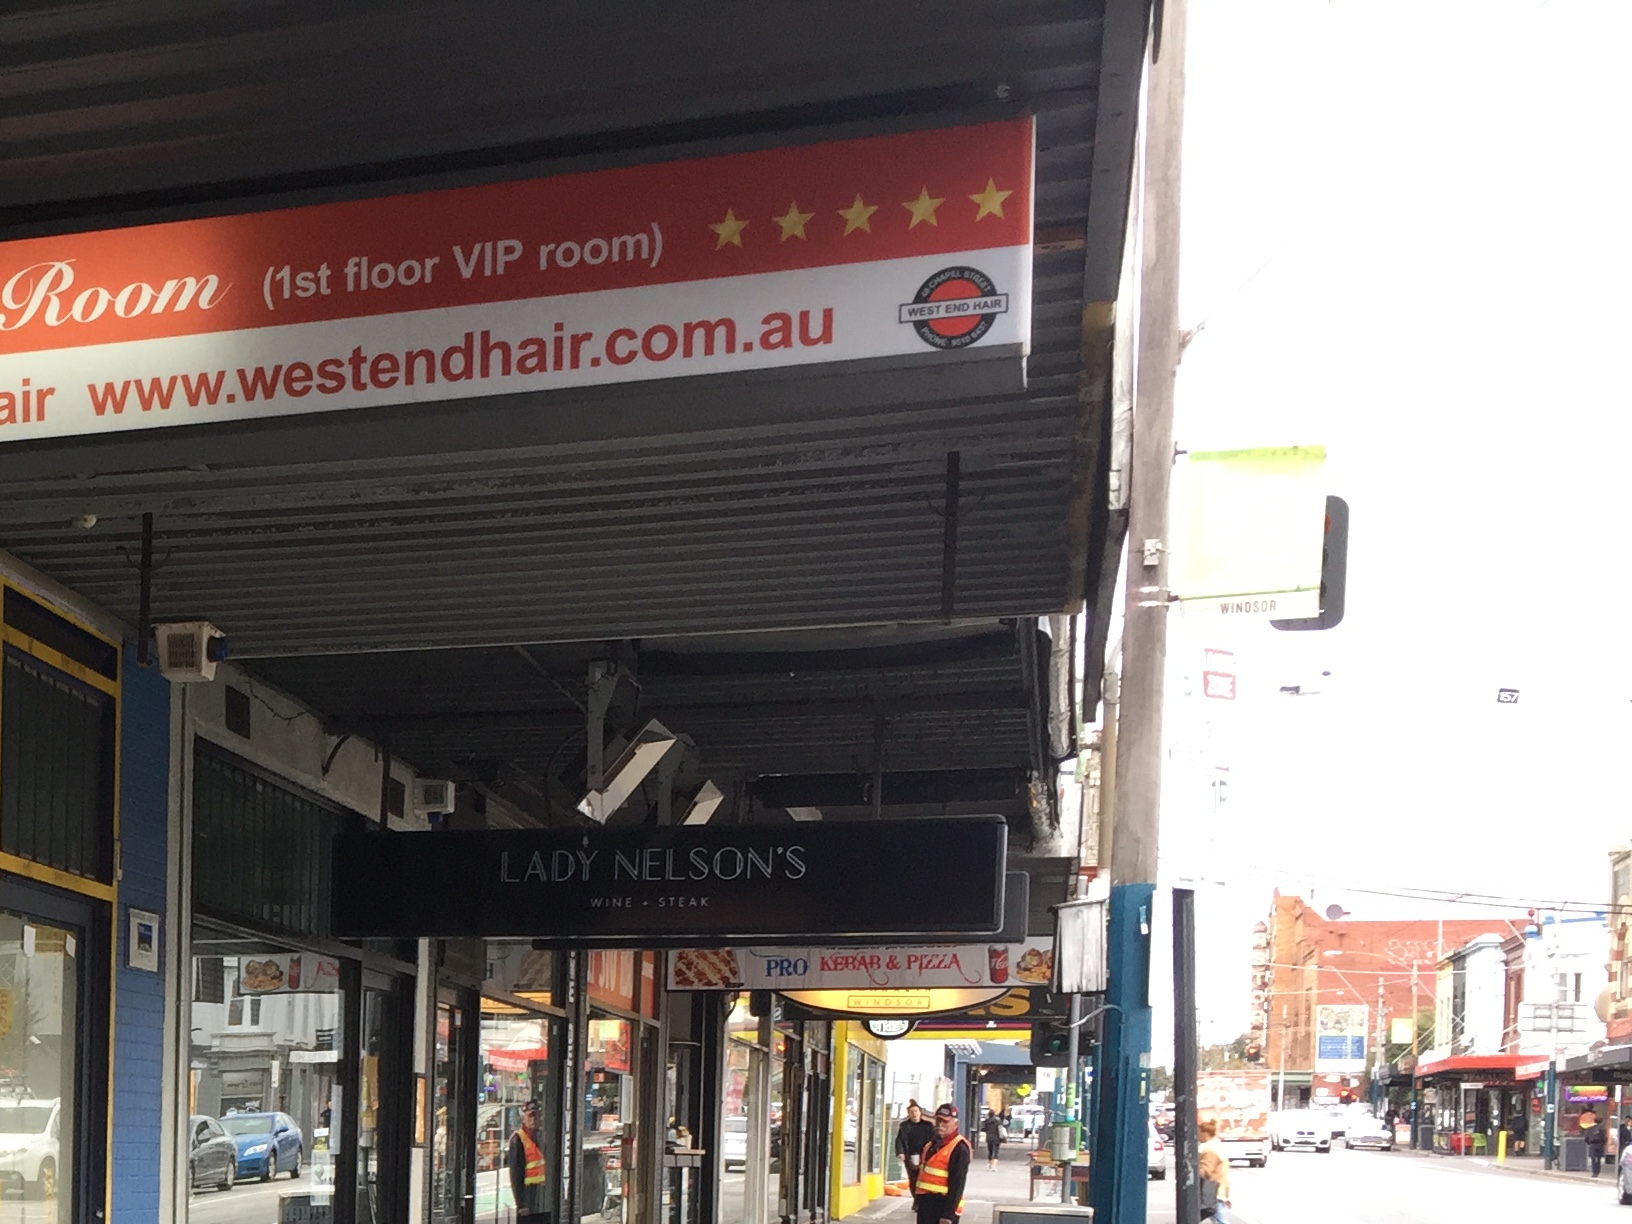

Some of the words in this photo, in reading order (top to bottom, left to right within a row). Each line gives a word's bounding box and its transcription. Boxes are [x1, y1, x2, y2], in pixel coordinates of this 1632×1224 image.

[262, 262, 332, 312] (1st
[344, 251, 440, 293] floor
[452, 239, 524, 279] VIP
[537, 221, 664, 272] room)
[929, 270, 961, 287] CHAPEL
[964, 271, 991, 291] STREET
[908, 306, 941, 317] WEST
[945, 303, 970, 313] END
[973, 299, 1001, 310] HAIR
[87, 306, 834, 416] www.westendhair.com.au
[1220, 599, 1277, 614] WINDSOR
[1499, 691, 1519, 702] 157
[499, 847, 599, 884] LADY
[614, 845, 807, 881] NELSON'S
[590, 897, 634, 909] WINE
[658, 895, 711, 908] STEAK
[765, 958, 808, 977] PRO
[820, 953, 883, 977] KEBAB
[886, 954, 901, 970] &
[905, 952, 963, 976] PIZZA
[854, 998, 923, 1006] WINDSOR
